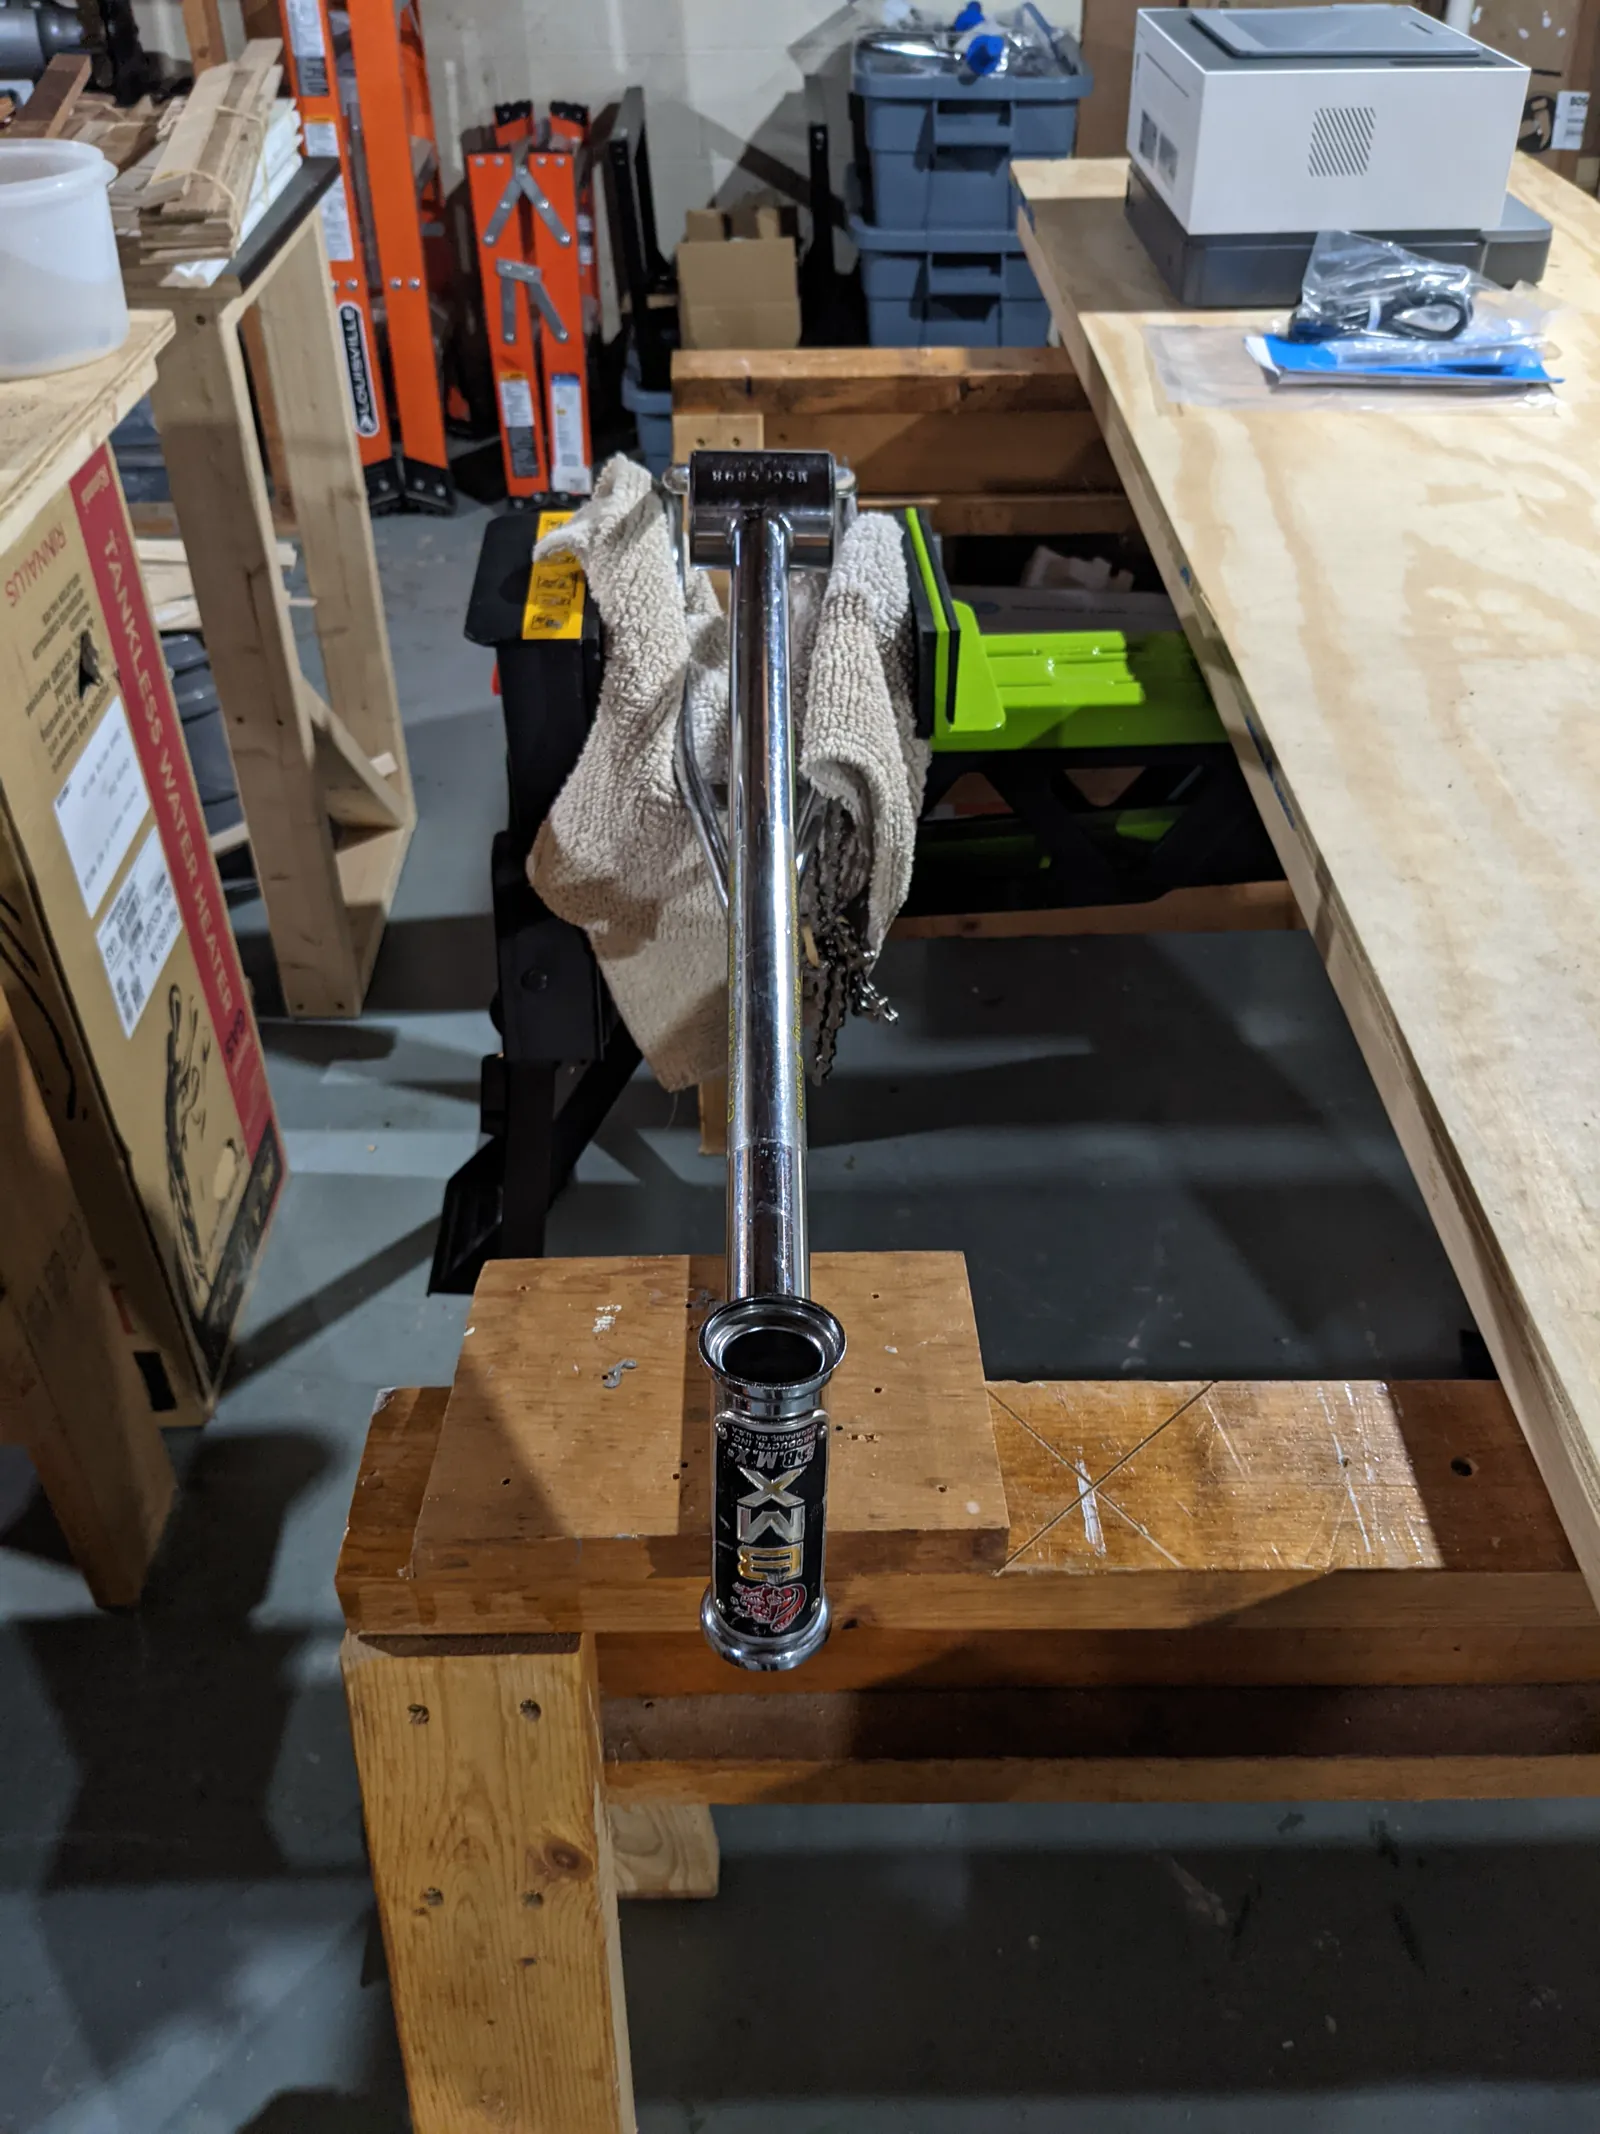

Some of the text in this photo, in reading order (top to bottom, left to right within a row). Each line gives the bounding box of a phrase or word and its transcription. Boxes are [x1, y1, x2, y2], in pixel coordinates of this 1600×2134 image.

[342, 307, 370, 414] LOUISVILLE
[105, 529, 163, 745] TANKLESS
[159, 749, 199, 884] WATER
[194, 885, 233, 1017] HEATER
[794, 1052, 804, 1121] Frame
[737, 1465, 807, 1583] BMX
